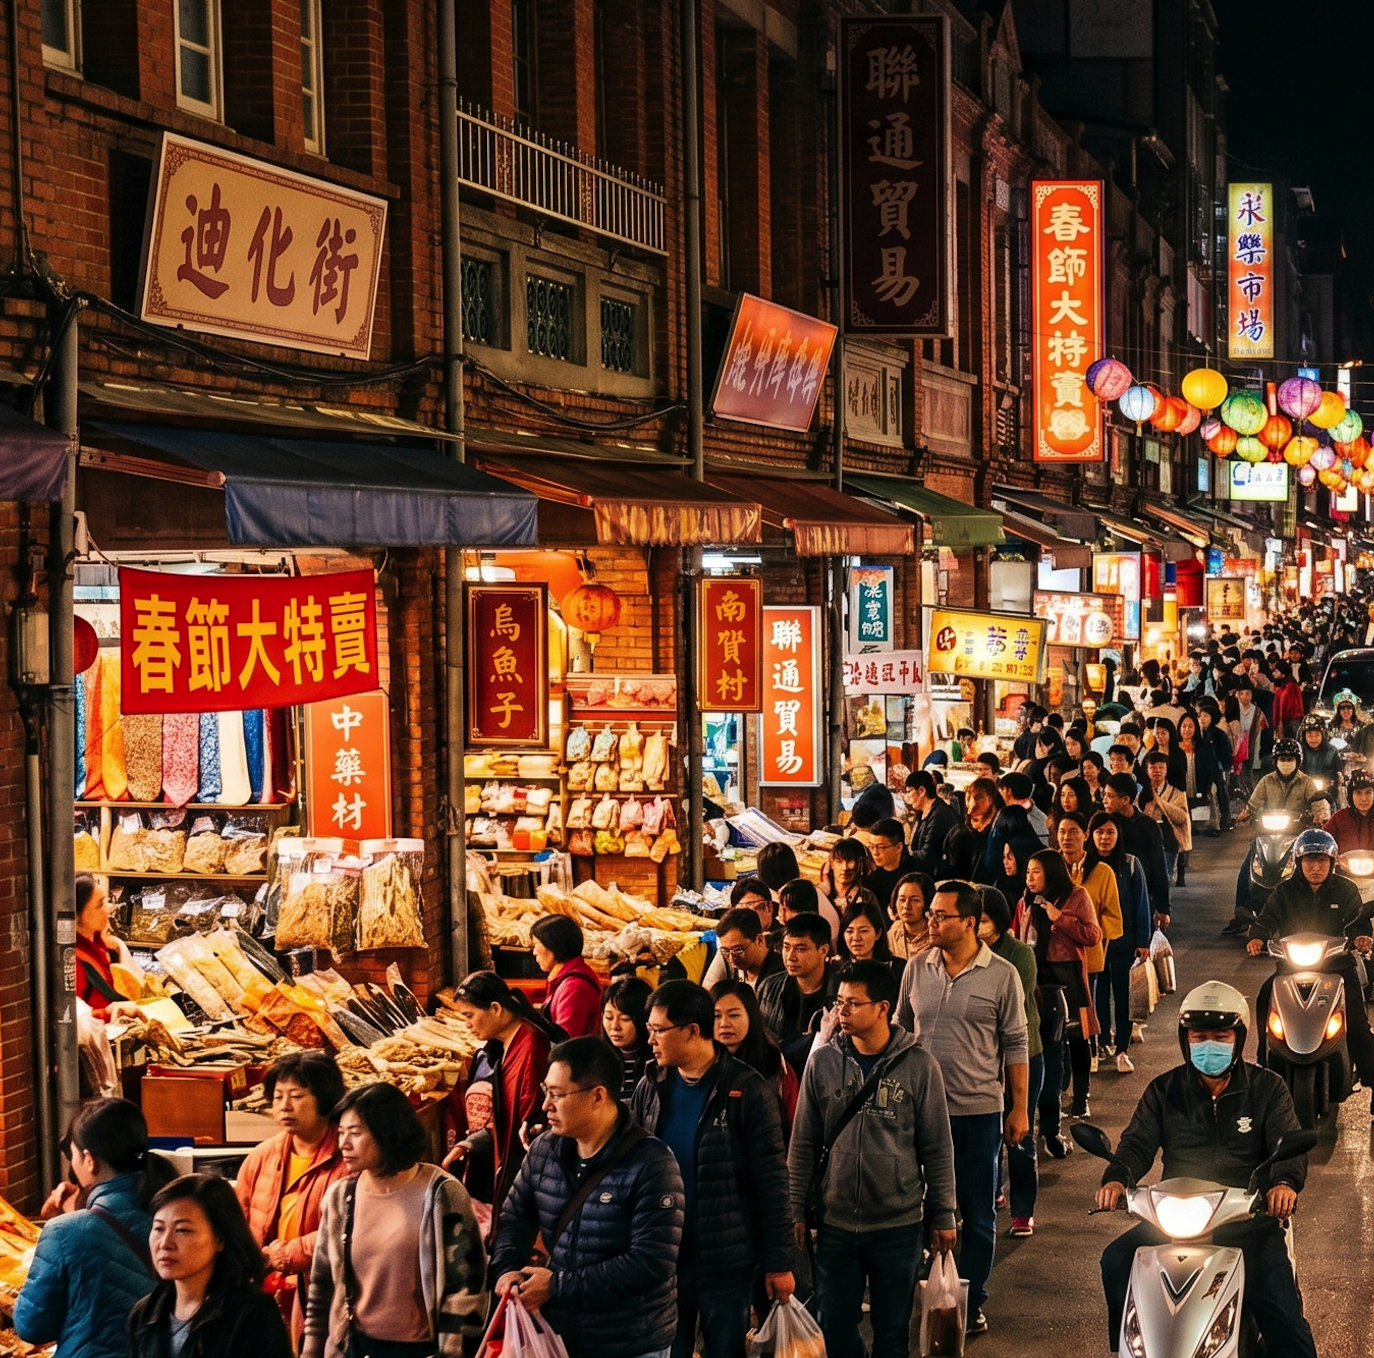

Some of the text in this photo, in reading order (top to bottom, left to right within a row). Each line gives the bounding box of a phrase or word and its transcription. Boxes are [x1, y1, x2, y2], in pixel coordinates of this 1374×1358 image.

[865, 44, 923, 307] 聯通貿易
[177, 182, 359, 325] 迪化街
[131, 591, 370, 694] 春節大特賣
[489, 603, 524, 728] 烏魚子
[770, 618, 805, 775] 聯通貿易
[330, 704, 368, 831] 中藥材
